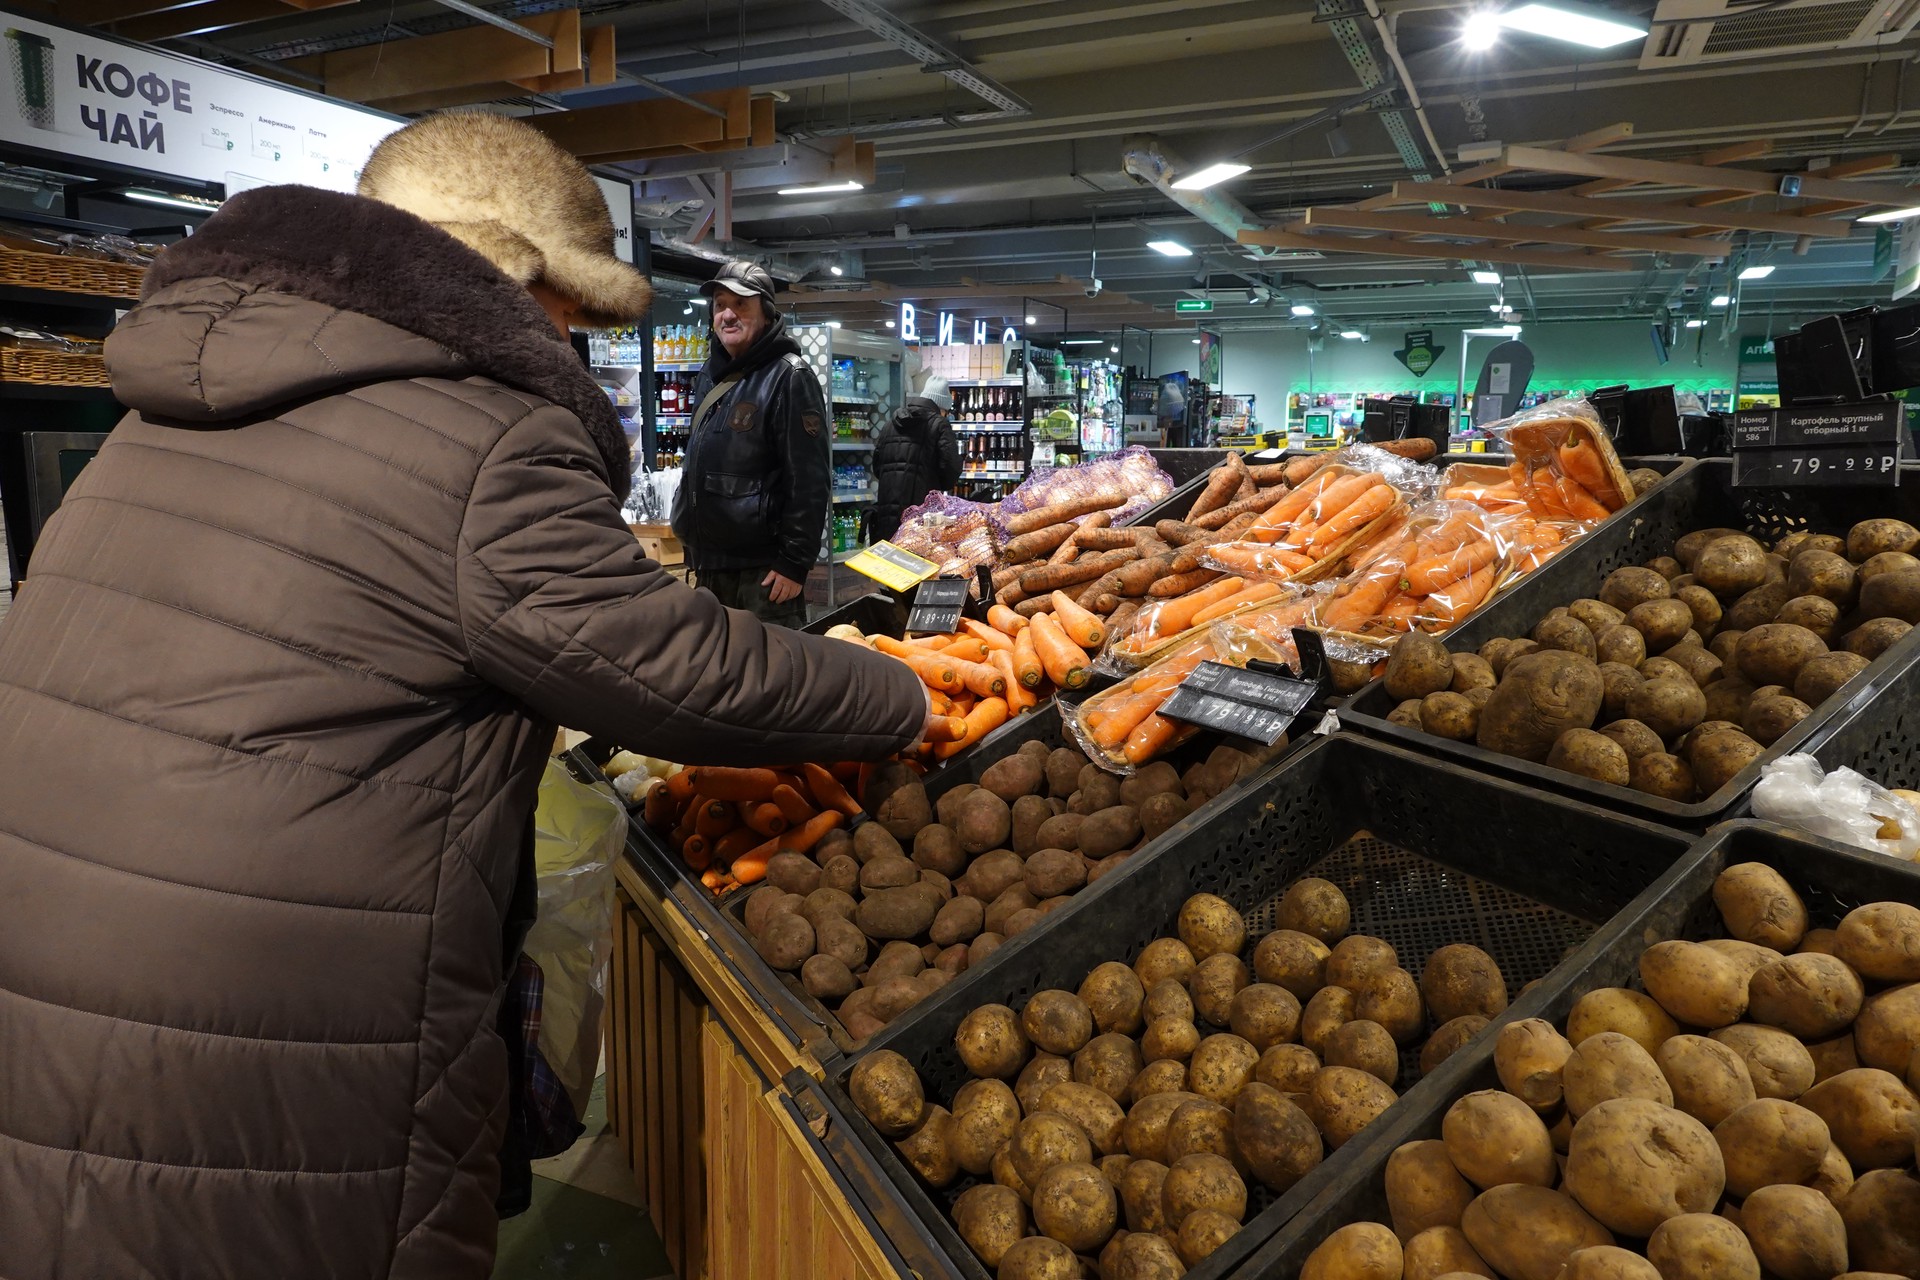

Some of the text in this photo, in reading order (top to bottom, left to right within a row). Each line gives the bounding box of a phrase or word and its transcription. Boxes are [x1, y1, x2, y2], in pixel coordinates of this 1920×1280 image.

[76, 54, 193, 114] КОФЕ
[210, 103, 244, 118] Эспрессо
[80, 104, 165, 154] ЧАЙ
[258, 116, 296, 131] Американо
[211, 128, 220, 136] 30
[308, 128, 327, 138] Латте
[260, 139, 272, 149] 200
[1740, 416, 1768, 424] Номер
[1791, 413, 1884, 426] Картофель крупный
[1804, 424, 1849, 435] отборный
[1852, 425, 1857, 433] 1
[1745, 433, 1760, 441] 586
